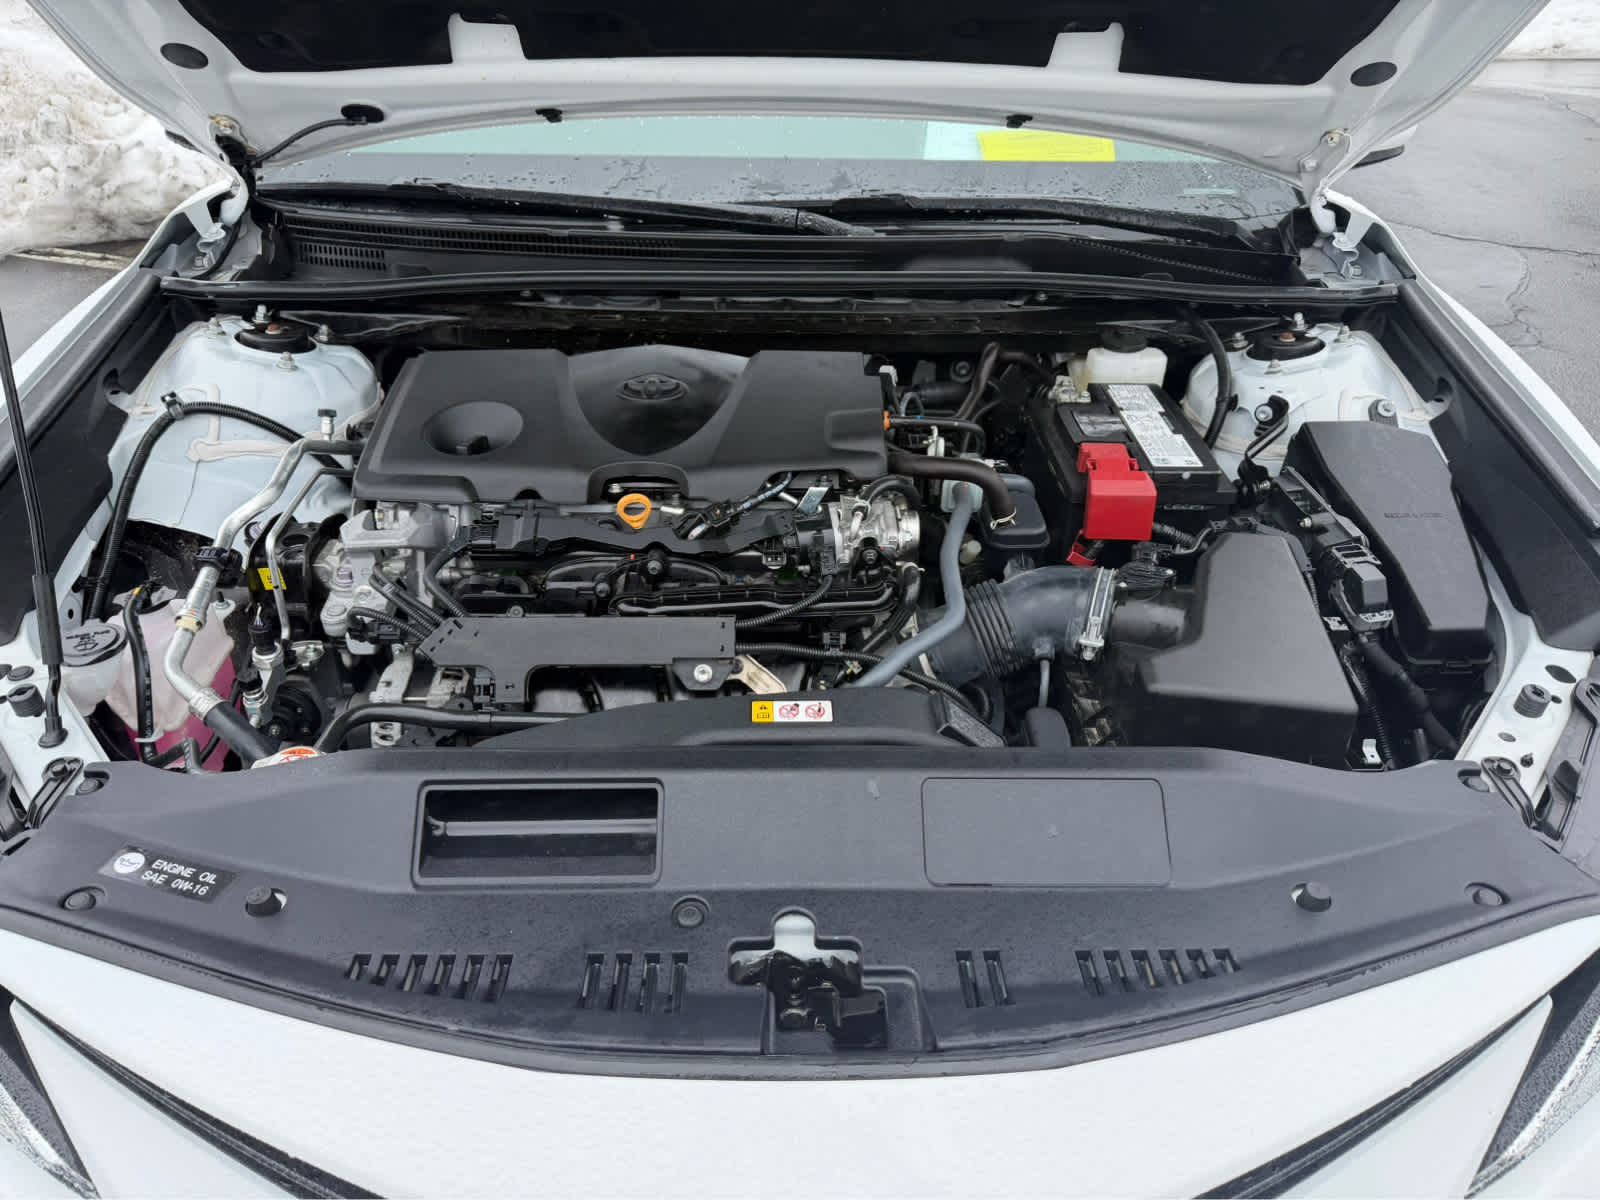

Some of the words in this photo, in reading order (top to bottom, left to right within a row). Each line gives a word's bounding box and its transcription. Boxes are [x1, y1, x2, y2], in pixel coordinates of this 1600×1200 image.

[141, 870, 169, 885] SAE
[170, 878, 209, 896] 0W-16
[152, 859, 196, 878] ENGINE
[199, 871, 217, 885] OIL
